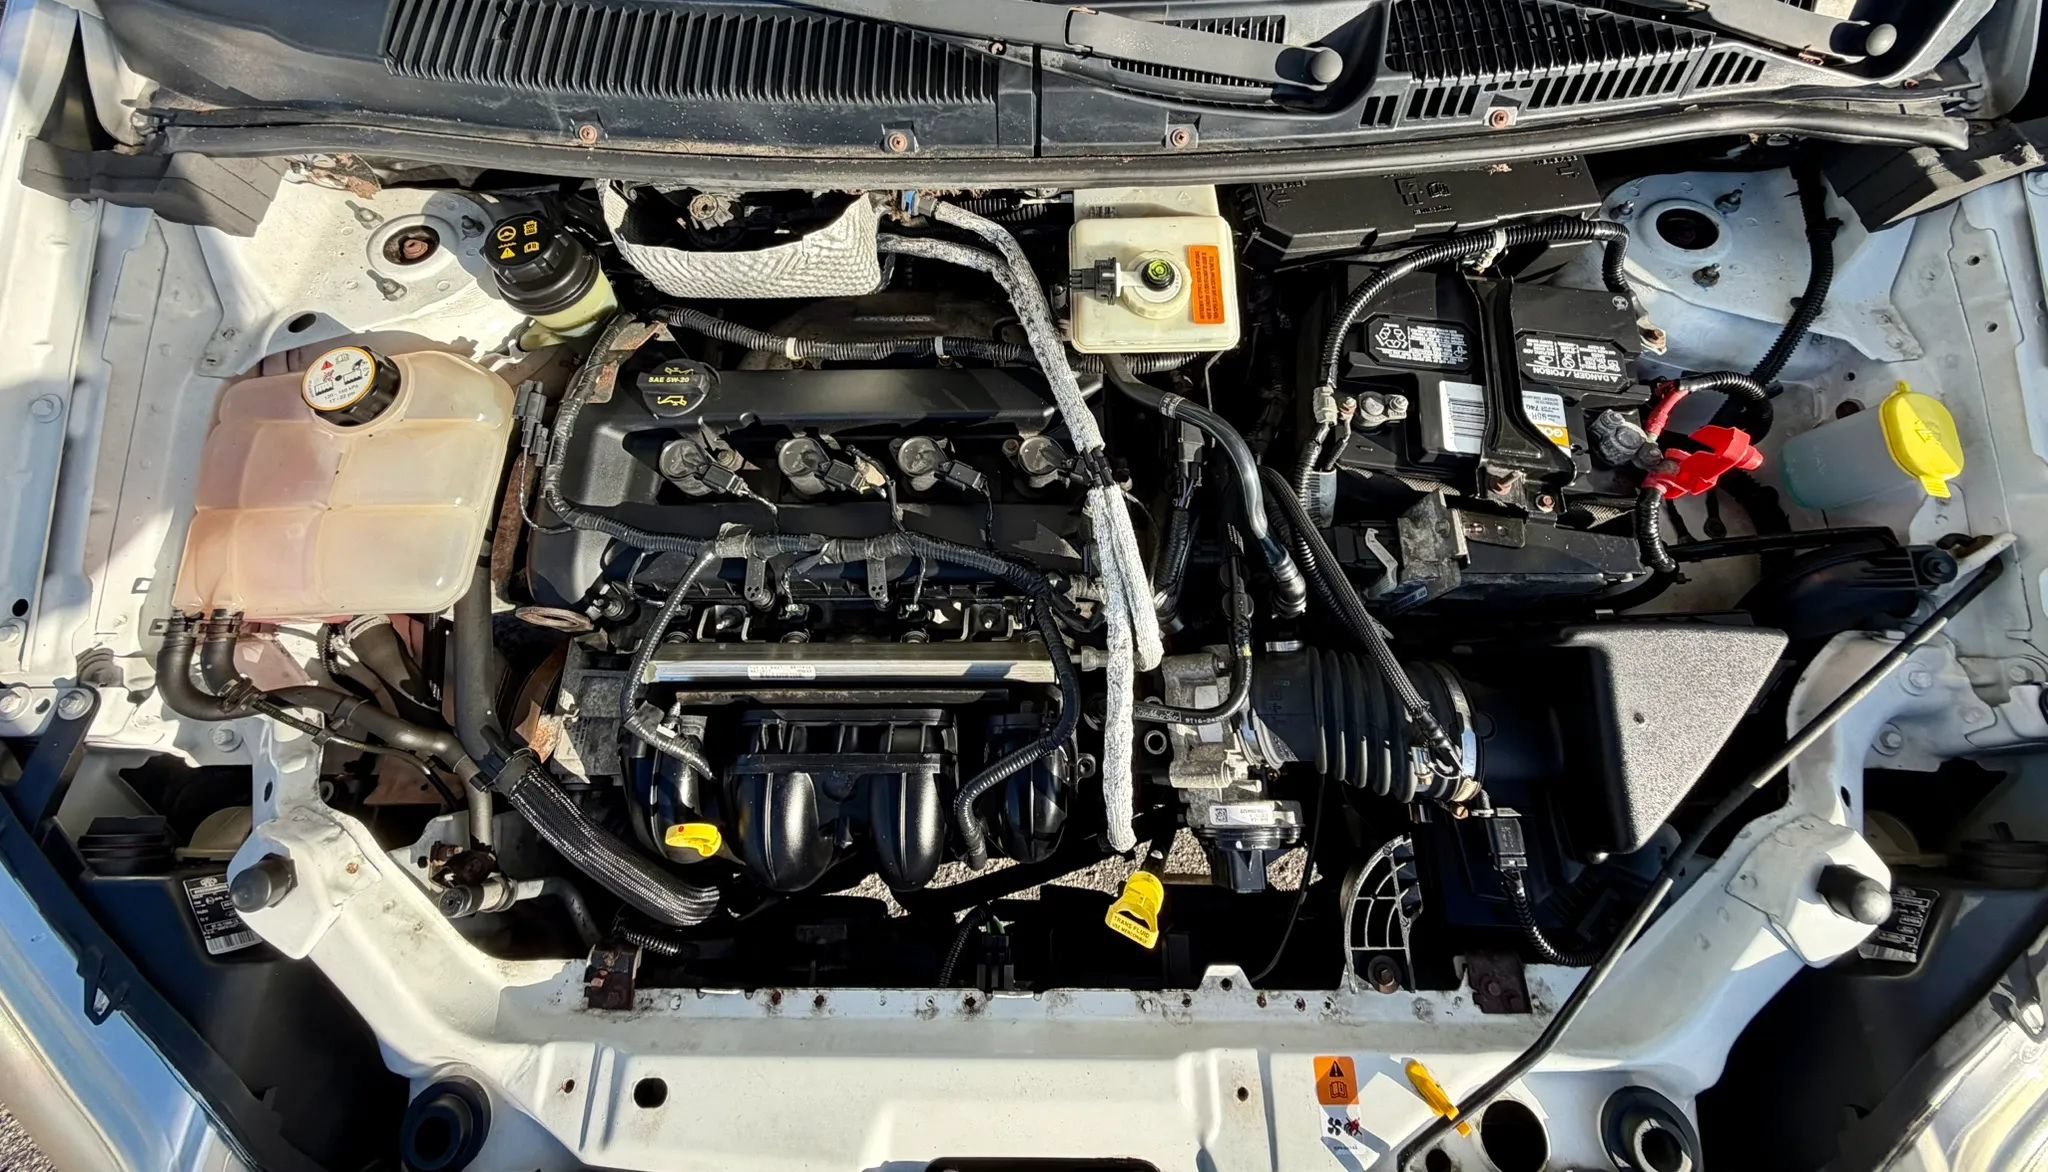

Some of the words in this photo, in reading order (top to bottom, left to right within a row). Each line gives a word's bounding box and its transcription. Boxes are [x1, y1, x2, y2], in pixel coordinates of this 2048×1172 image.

[1574, 370, 1610, 382] DANGER
[1114, 916, 1132, 929] TRANS
[1133, 926, 1150, 938] FLUID
